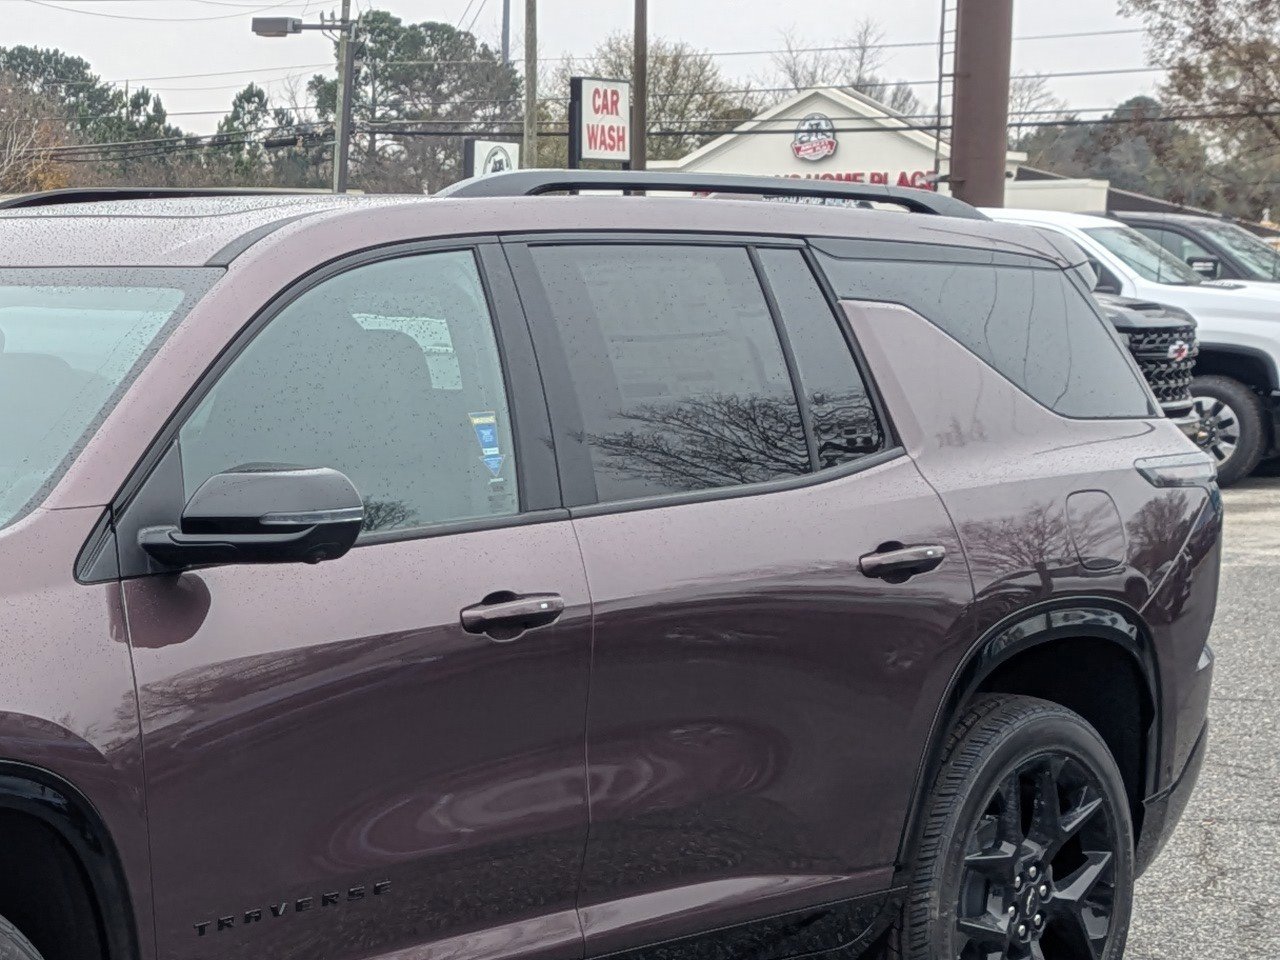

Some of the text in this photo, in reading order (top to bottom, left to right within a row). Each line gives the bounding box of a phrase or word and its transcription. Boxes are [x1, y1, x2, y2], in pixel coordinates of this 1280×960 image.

[592, 87, 620, 116] CAR
[586, 123, 626, 151] WASH
[192, 880, 392, 937] TRAVERSE
